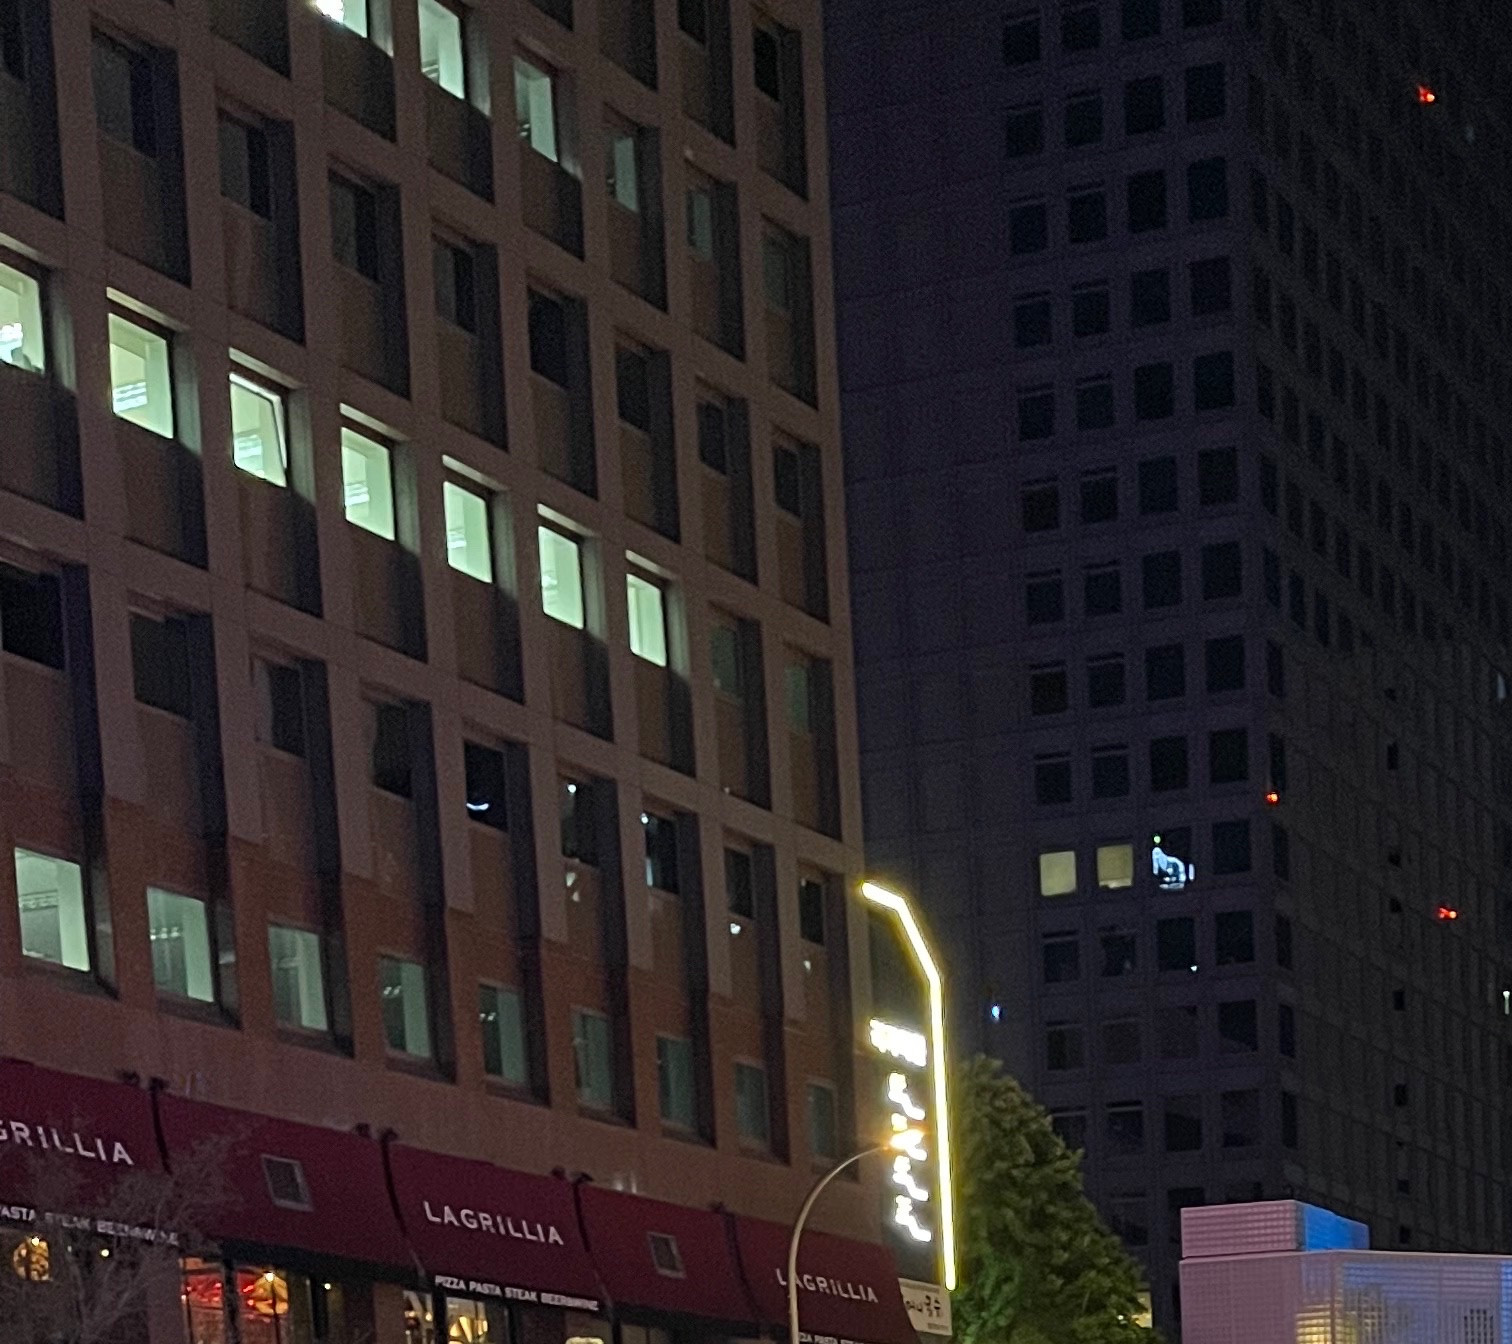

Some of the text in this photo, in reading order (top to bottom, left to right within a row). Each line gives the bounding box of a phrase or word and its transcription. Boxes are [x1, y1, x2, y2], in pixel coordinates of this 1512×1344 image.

[0, 1205, 36, 1221] ASTA
[423, 1200, 564, 1245] LAGRILLIA
[435, 1275, 467, 1291] PIZZA
[469, 1280, 502, 1296] PASTA
[504, 1287, 538, 1301] STEAK
